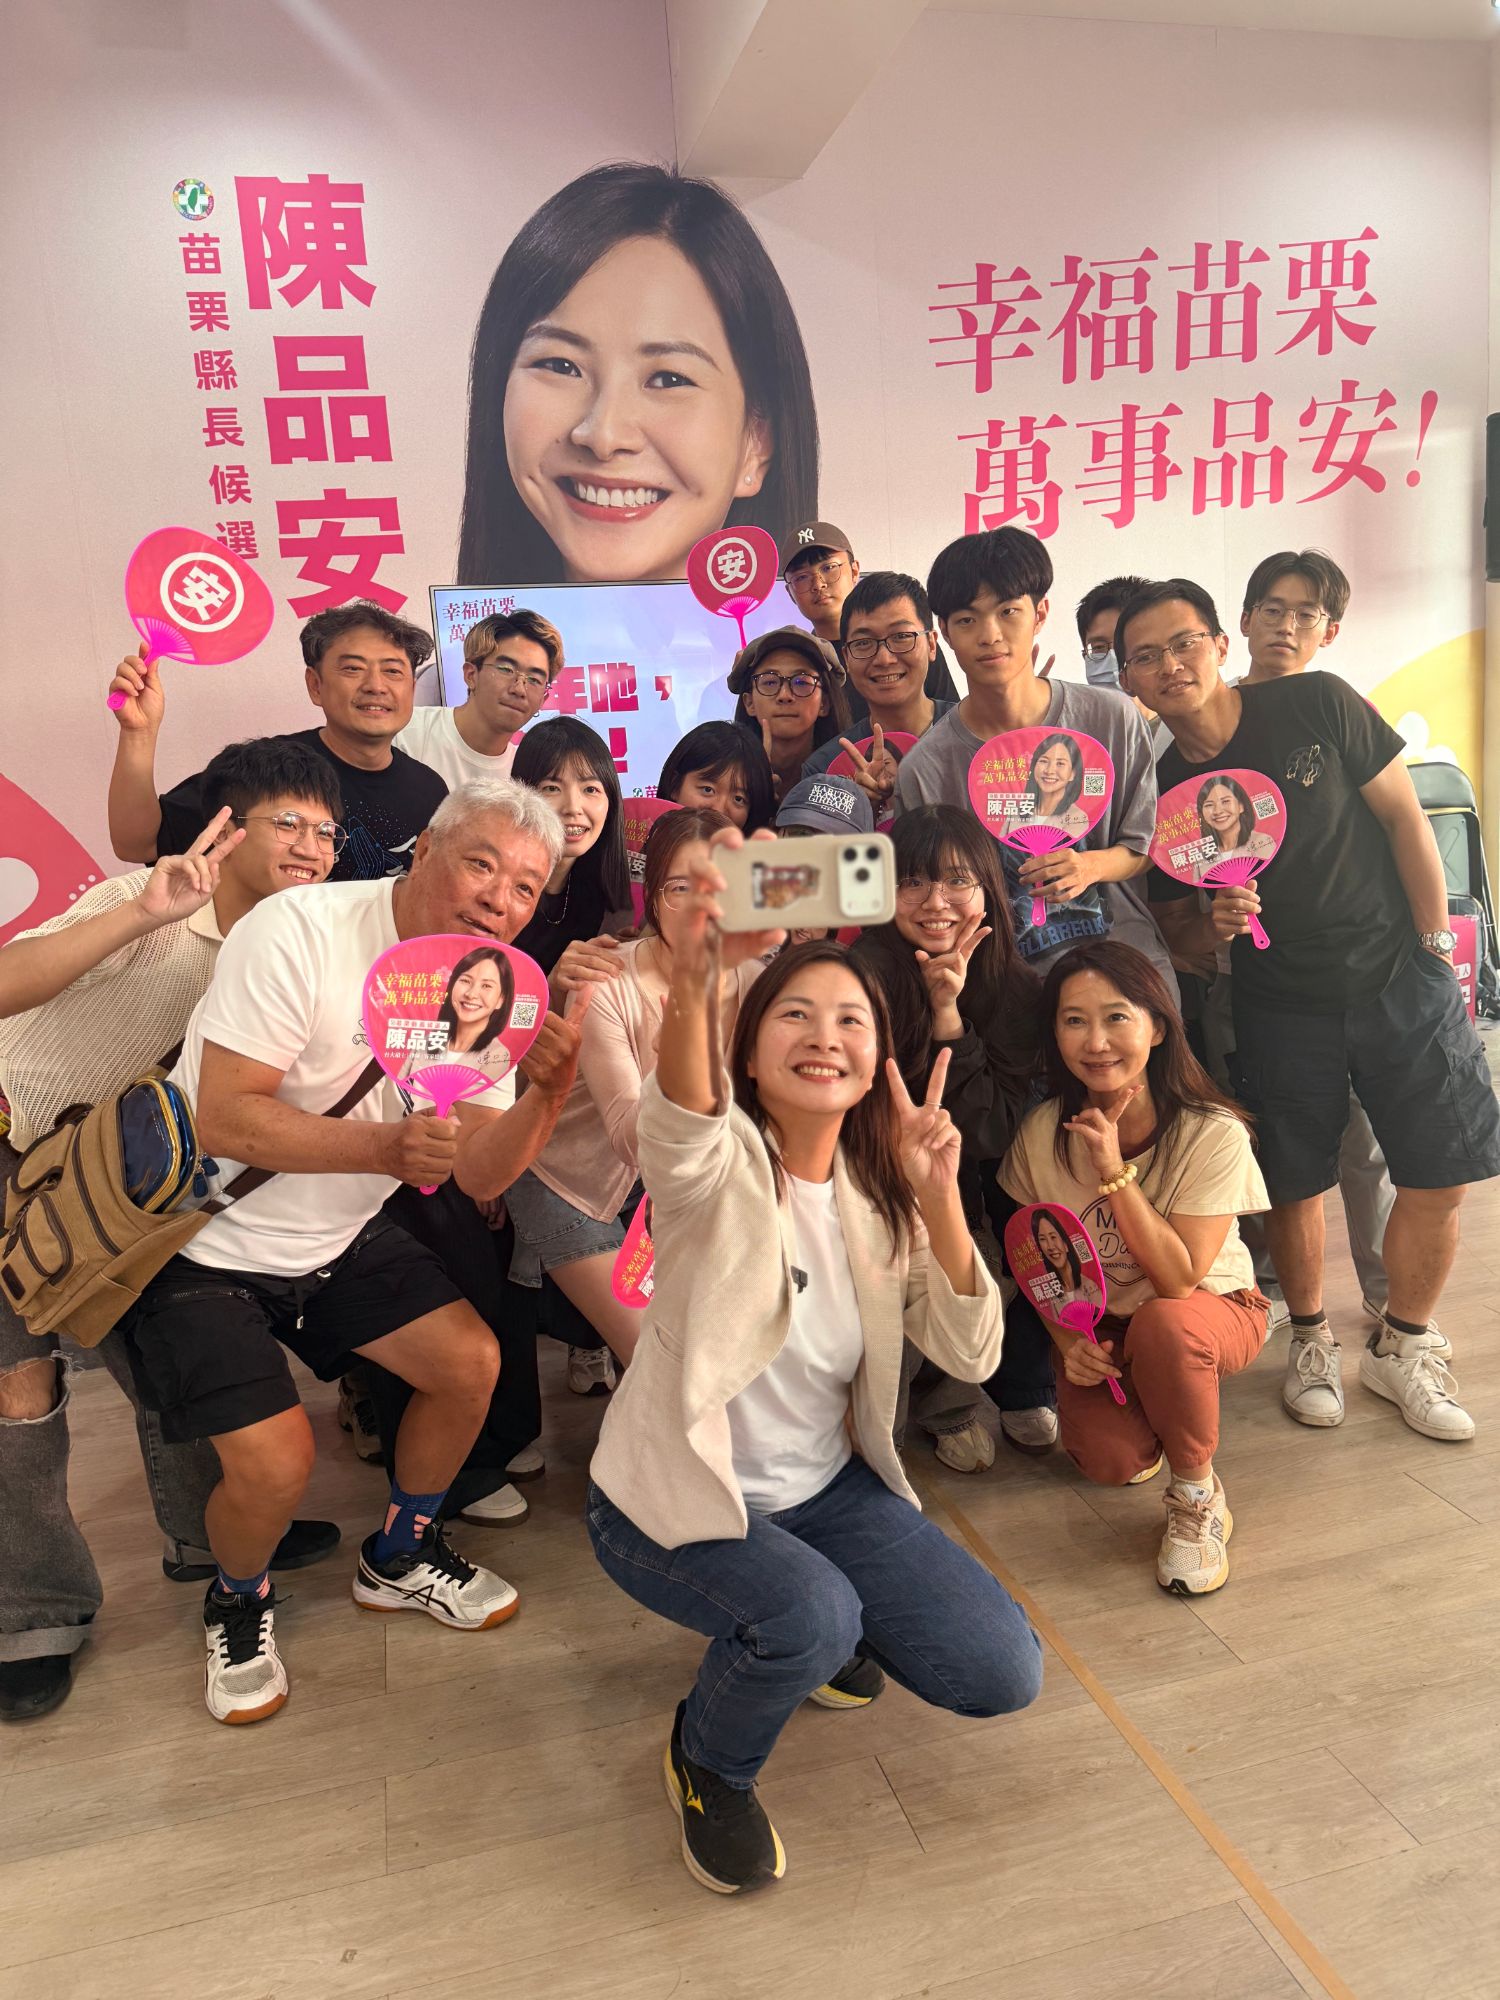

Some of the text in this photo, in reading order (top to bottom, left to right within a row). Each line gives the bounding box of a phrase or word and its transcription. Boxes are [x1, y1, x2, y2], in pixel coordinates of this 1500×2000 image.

[929, 226, 1378, 393] 幸福苗栗
[179, 232, 259, 560] 苗栗縣長候選
[234, 174, 408, 618] 陳品安
[957, 379, 1438, 540] 萬事品安!
[717, 549, 747, 584] 安
[173, 566, 230, 621] 安
[442, 595, 515, 621] 幸福苗栗
[448, 622, 477, 643] 萬
[987, 800, 1035, 816] 陳品安
[1170, 842, 1219, 869] 陳品安
[384, 972, 443, 988] 幸福苗栗
[383, 991, 449, 1006] 萬事品安!
[386, 1028, 449, 1051] 陳品安
